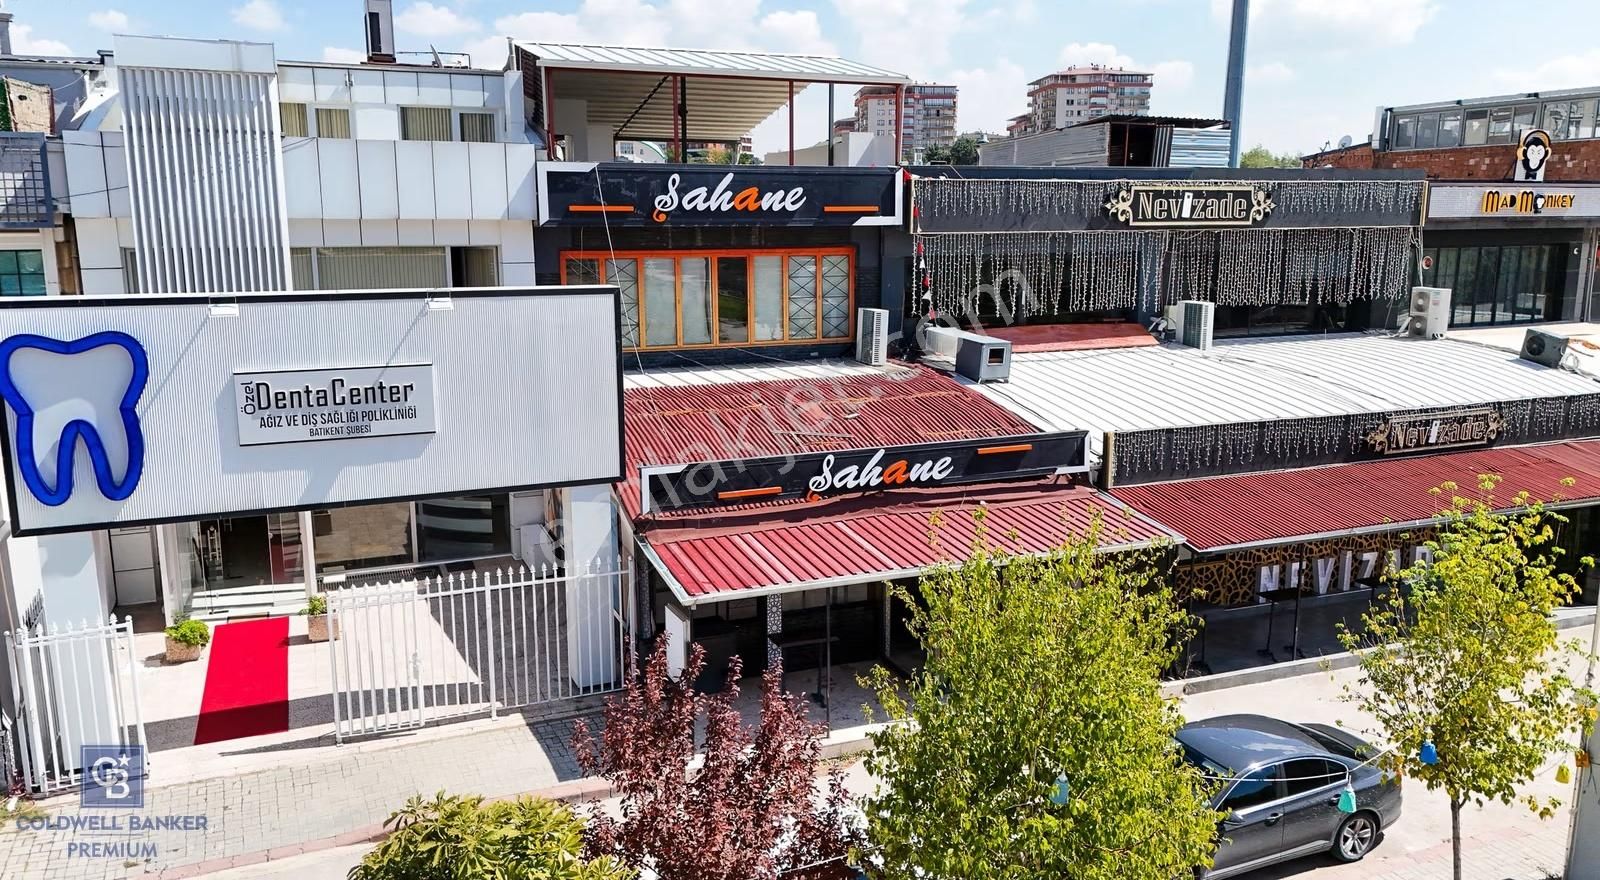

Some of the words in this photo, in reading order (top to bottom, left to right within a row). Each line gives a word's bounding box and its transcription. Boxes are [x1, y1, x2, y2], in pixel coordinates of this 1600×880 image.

[653, 172, 806, 222] Sahane
[1482, 190, 1517, 213] MAD
[255, 378, 415, 411] DentaCenter
[259, 414, 283, 429] AĞIZ
[285, 414, 299, 427] VE
[302, 412, 318, 427] DİŞ
[320, 409, 359, 425] SAĞLIĞI
[361, 405, 417, 422] POLİKLİNİĞİ
[309, 426, 344, 437] BATIKENT
[346, 424, 372, 436] ŞUBESİ
[807, 448, 955, 503] Sahane
